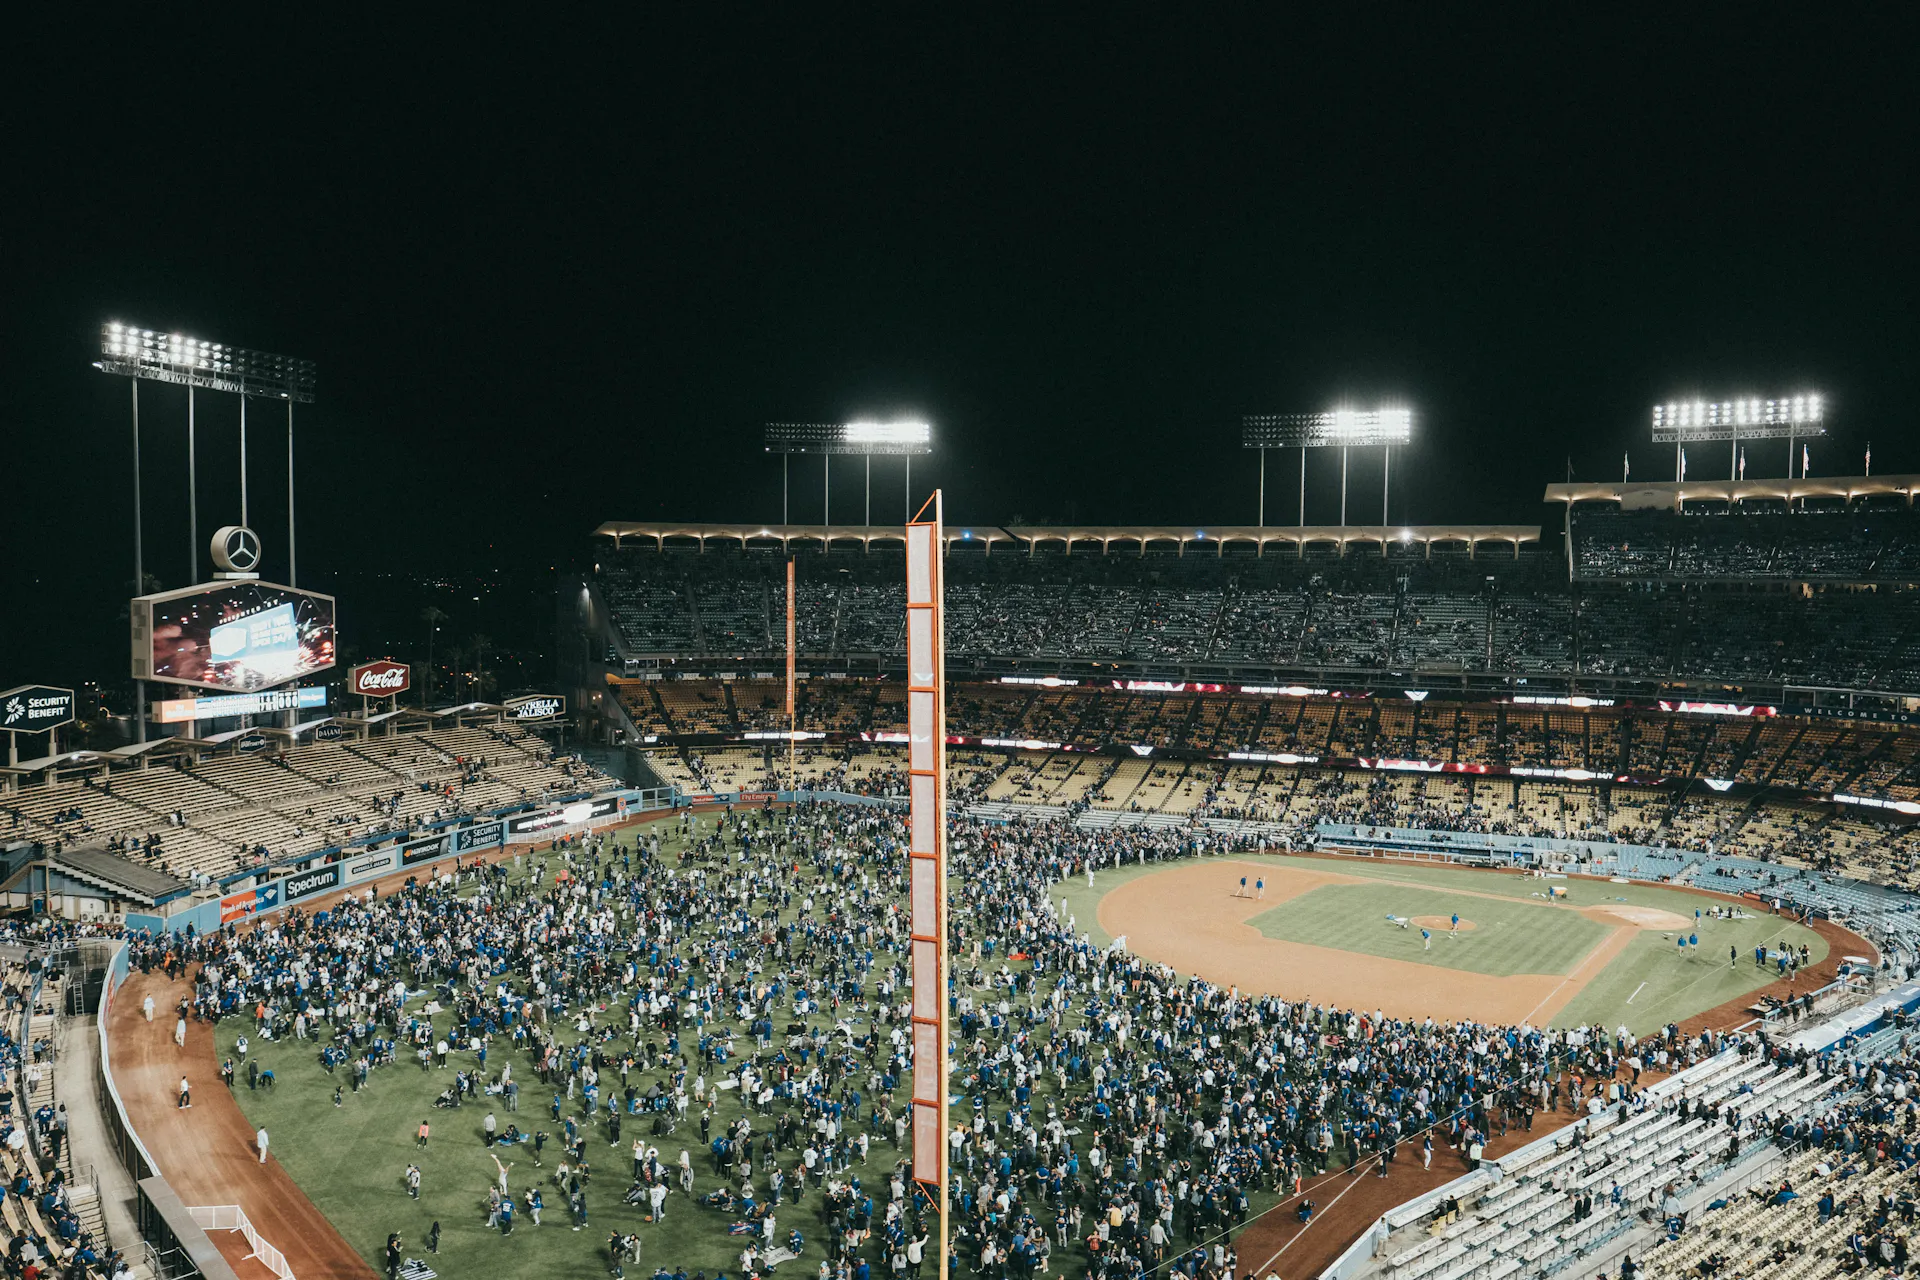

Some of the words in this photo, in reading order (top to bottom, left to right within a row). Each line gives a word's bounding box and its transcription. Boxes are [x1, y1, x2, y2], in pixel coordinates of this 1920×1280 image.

[359, 668, 406, 690] Coca-Cola
[28, 696, 70, 708] SECURITY
[28, 707, 65, 719] BENEFIT
[517, 707, 554, 718] JALISCO
[1804, 707, 1877, 719] WELCOME
[318, 728, 340, 737] DASANI
[473, 825, 501, 837] SECURITY
[472, 834, 498, 846] BENEFIT
[287, 872, 334, 896] Spectrum
[221, 904, 236, 915] Bank
